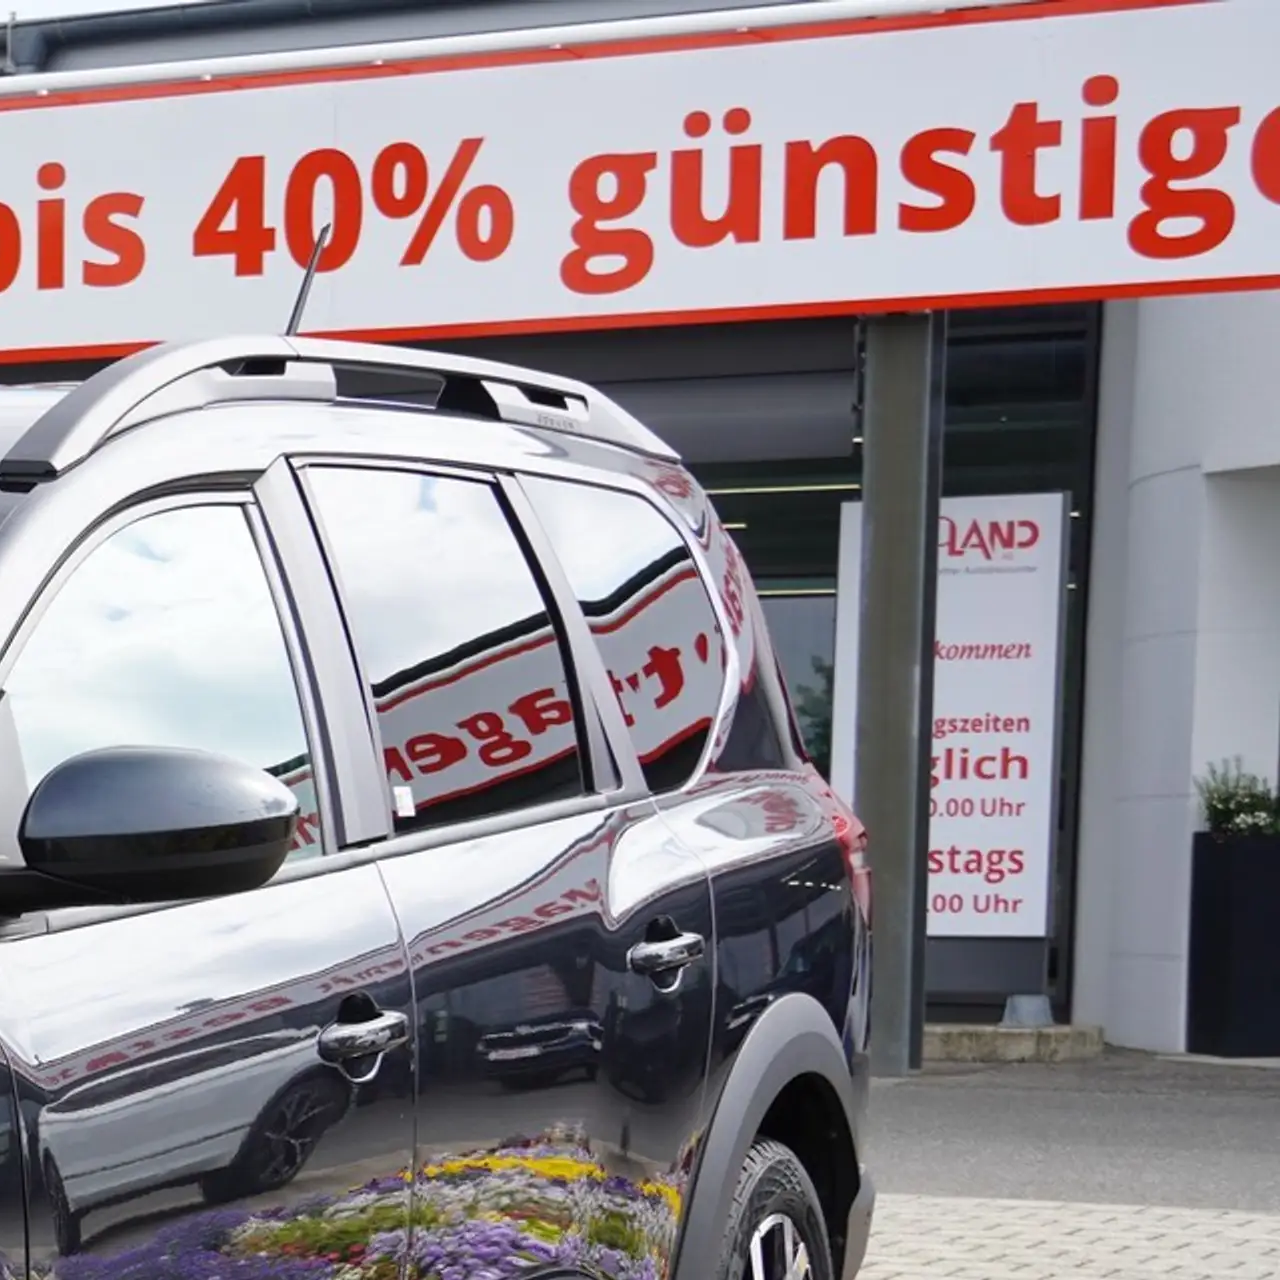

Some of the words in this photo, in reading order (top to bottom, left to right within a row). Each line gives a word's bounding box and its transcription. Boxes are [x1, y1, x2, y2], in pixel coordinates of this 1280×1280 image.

[190, 136, 516, 279] 40%
[980, 796, 1027, 818] Uhr
[972, 892, 1025, 914] Uhr
